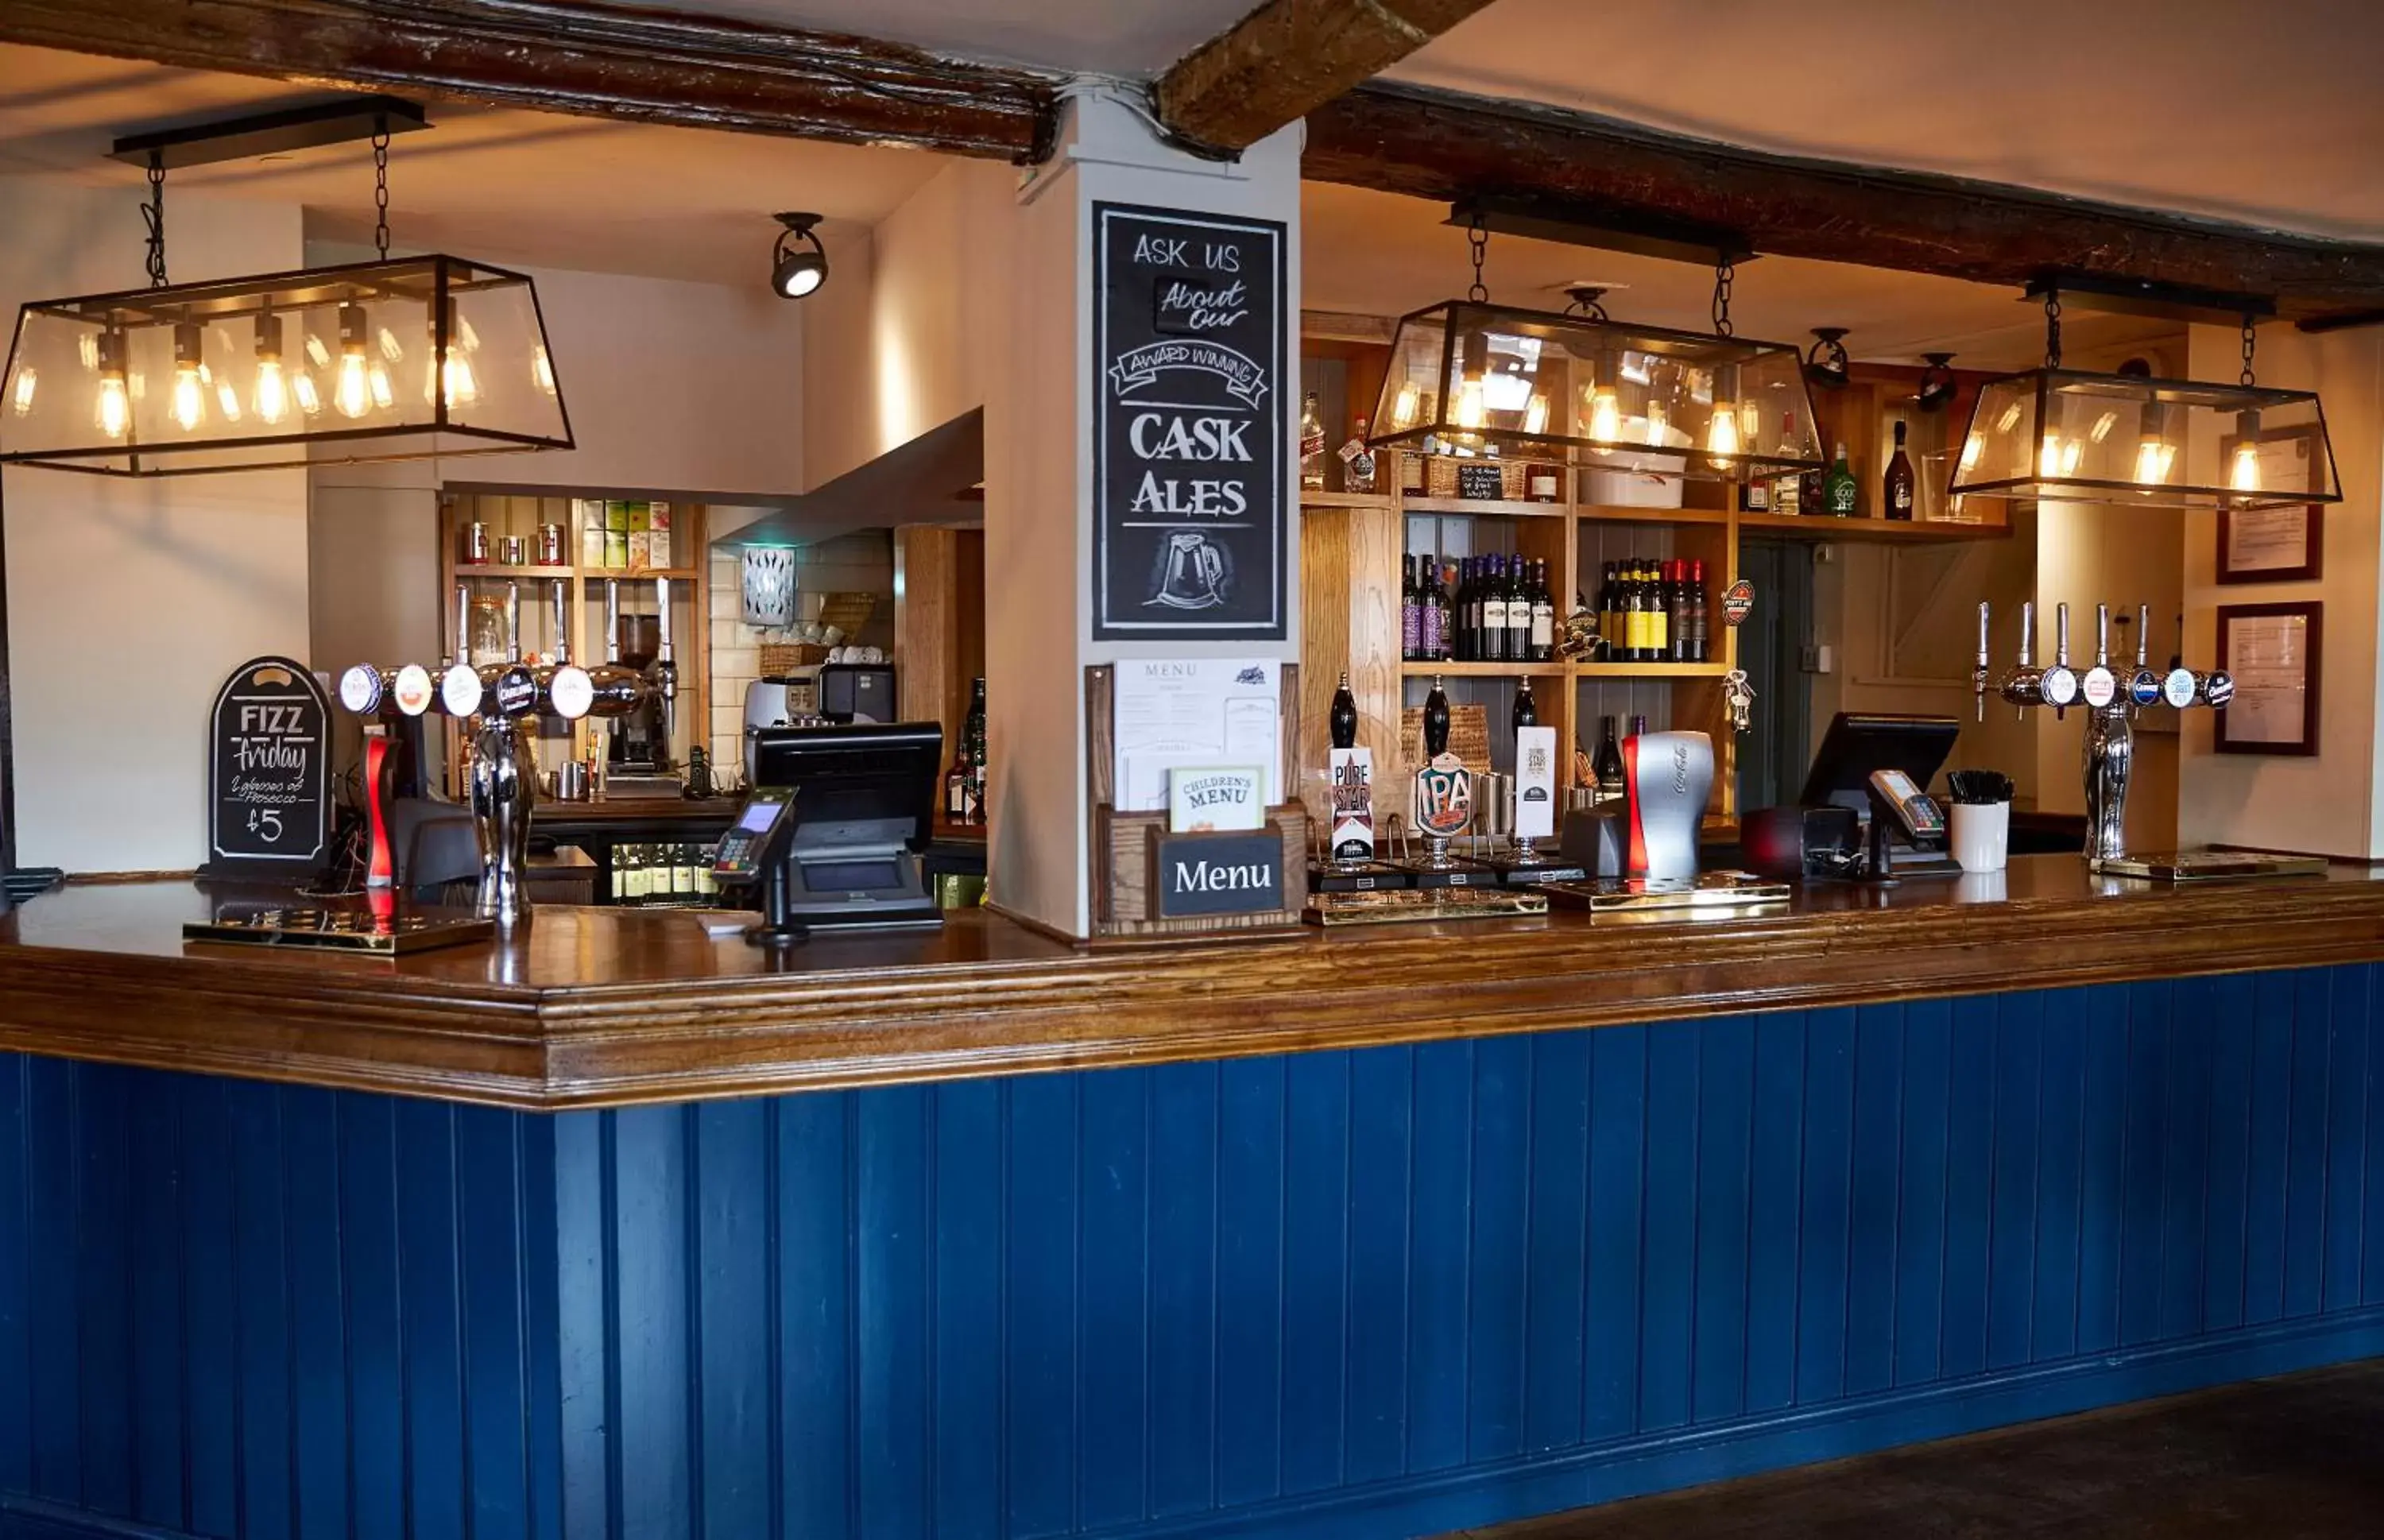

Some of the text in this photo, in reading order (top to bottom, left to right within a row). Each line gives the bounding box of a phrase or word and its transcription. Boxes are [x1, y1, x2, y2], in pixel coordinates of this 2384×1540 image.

[1133, 233, 1240, 273] ASK US
[1161, 280, 1247, 312] About
[1189, 309, 1248, 330] Our
[1130, 346, 1252, 382] AWARD WINNING
[1129, 413, 1253, 462] CASK
[1130, 470, 1247, 518] ALES
[1145, 663, 1197, 677] MENU
[240, 705, 304, 733] FIZZ
[233, 737, 307, 780] friday
[231, 775, 241, 792] 2
[1183, 776, 1251, 794] CHILDREN'S
[1335, 765, 1368, 786] PURE
[1189, 788, 1248, 809] MENU
[1335, 787, 1368, 811] STAR
[1419, 772, 1470, 818] IPA
[246, 807, 283, 843] £5
[1174, 861, 1272, 893] Menu
